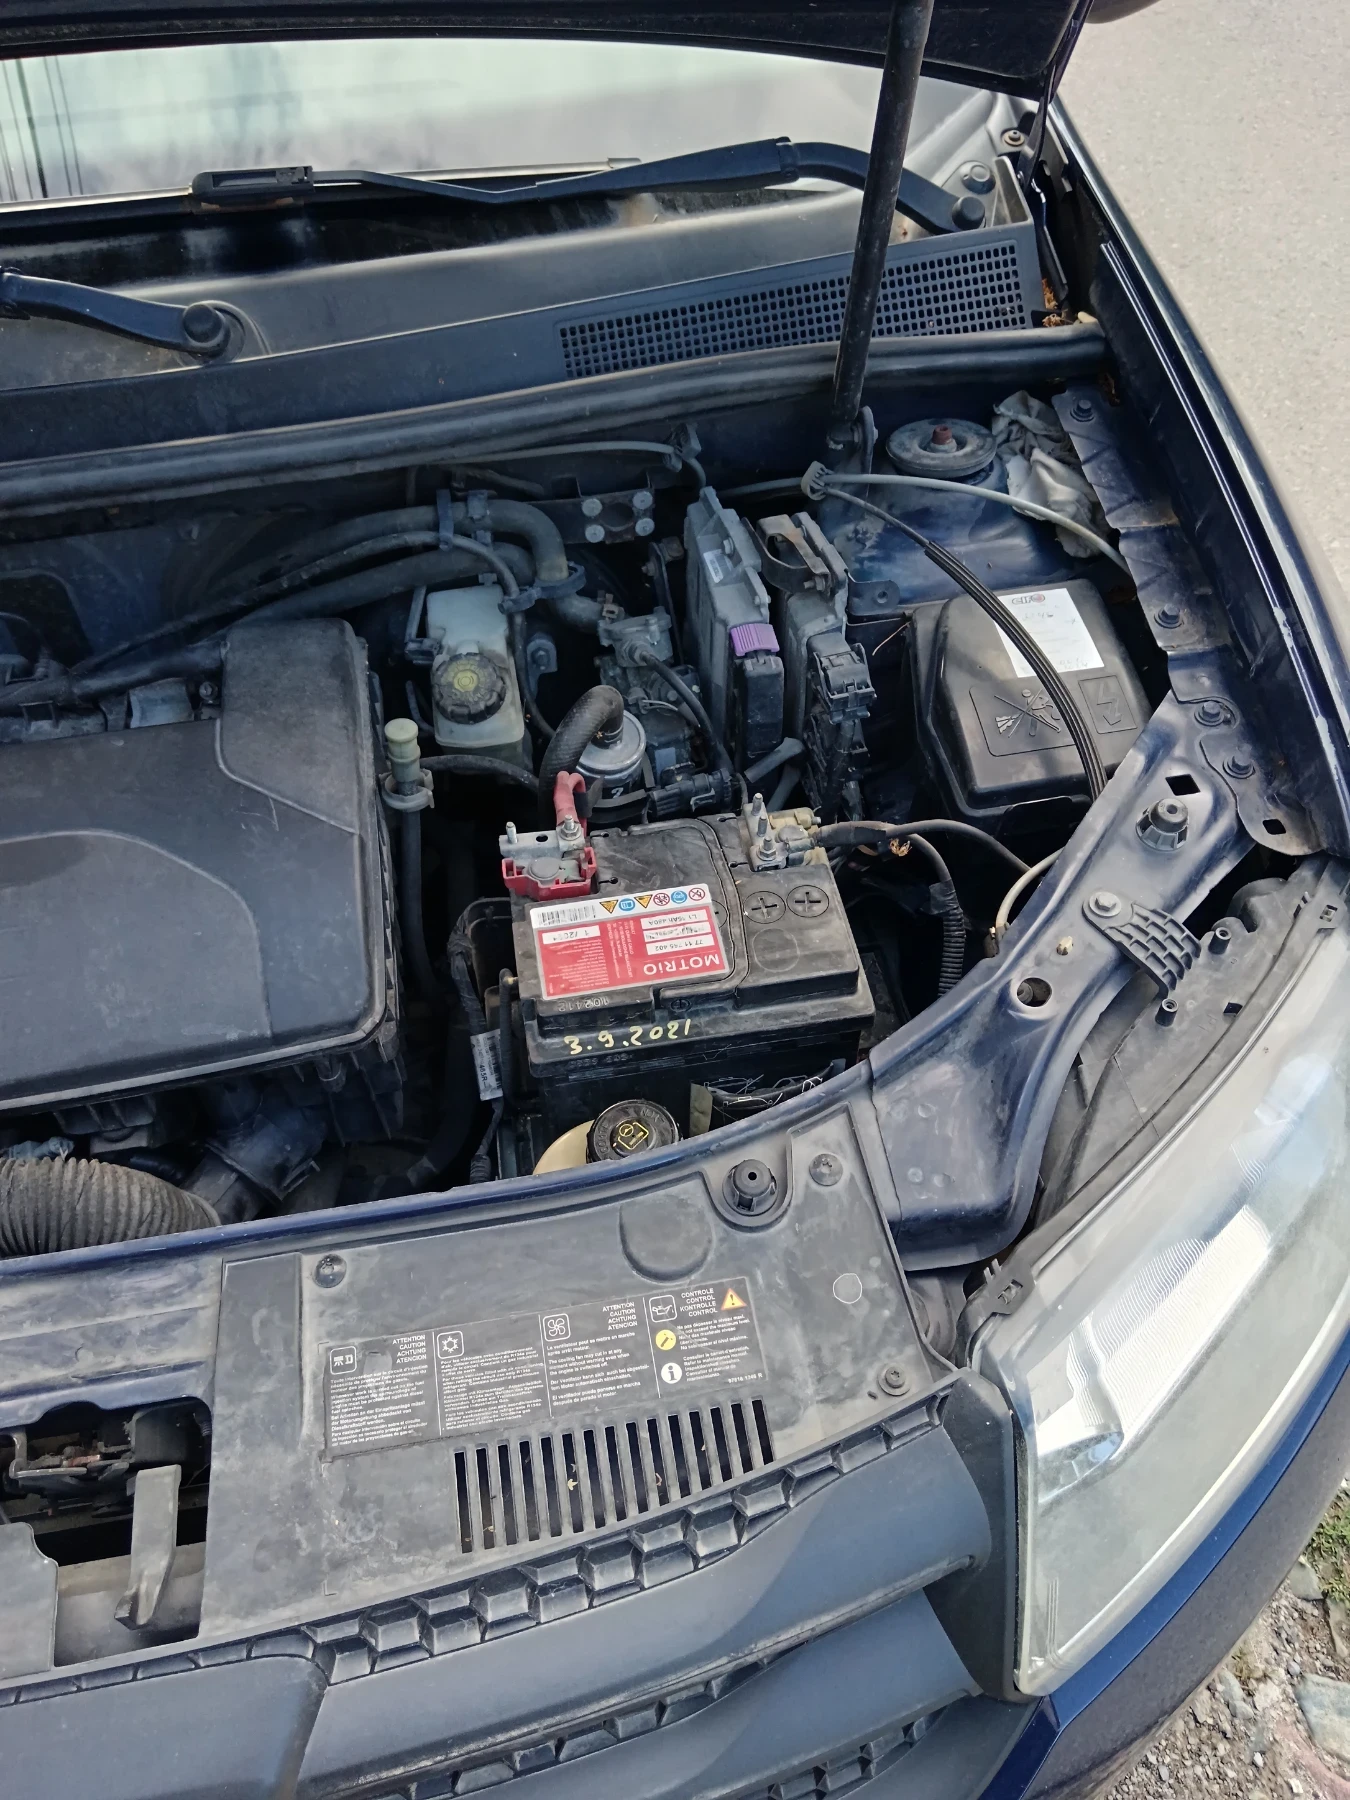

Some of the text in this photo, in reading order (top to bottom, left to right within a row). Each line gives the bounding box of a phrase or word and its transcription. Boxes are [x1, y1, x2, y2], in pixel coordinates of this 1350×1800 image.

[643, 954, 720, 975] MOTRiO
[681, 1288, 714, 1298] CONTROLE
[686, 1295, 715, 1304] CONTROL
[603, 1302, 634, 1311] ATTENTION
[680, 1301, 716, 1311] KONTROLLE
[610, 1308, 635, 1316] CAUTION
[689, 1308, 718, 1316] CONTROL
[608, 1315, 636, 1323] ACHTUNG
[608, 1321, 637, 1330] ATENCION
[393, 1335, 425, 1344] ATTENTION
[400, 1341, 426, 1350] CAUTION
[397, 1348, 426, 1356] ACHTUNG
[397, 1354, 426, 1363] ATENCION
